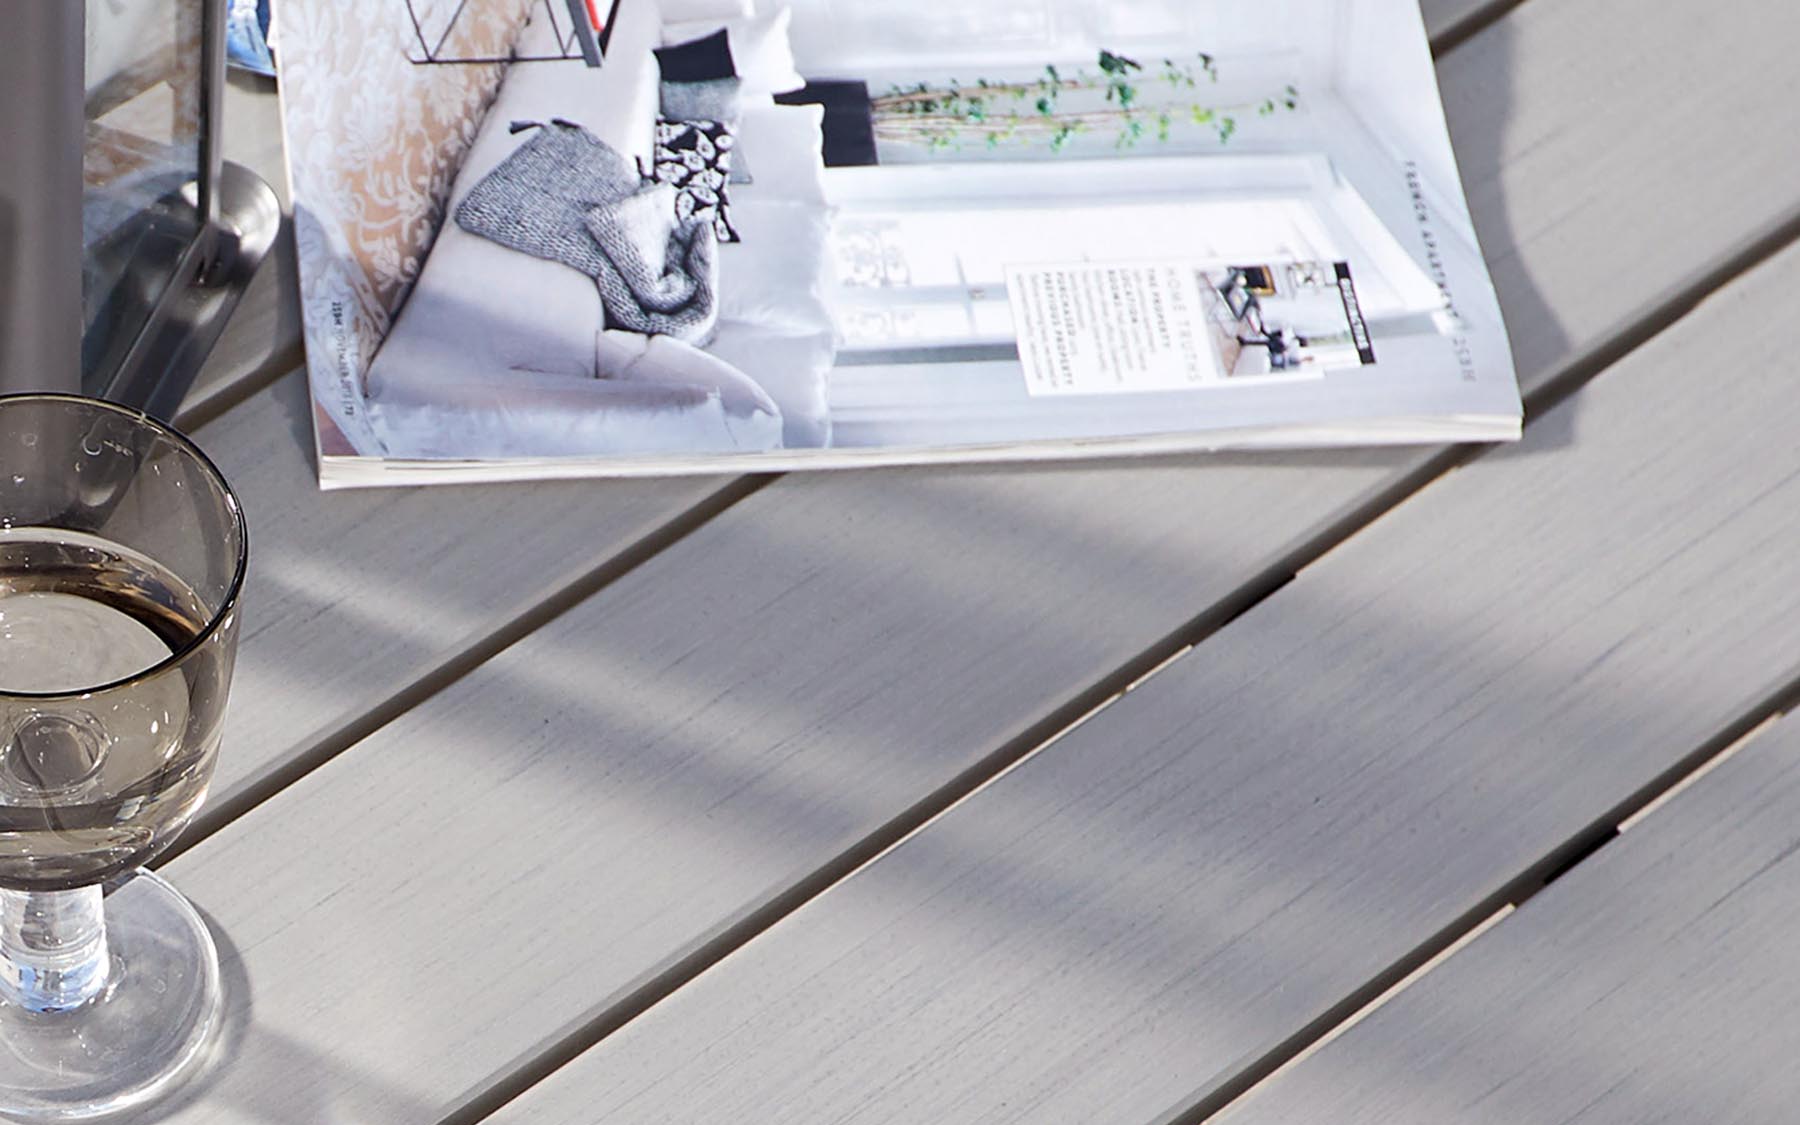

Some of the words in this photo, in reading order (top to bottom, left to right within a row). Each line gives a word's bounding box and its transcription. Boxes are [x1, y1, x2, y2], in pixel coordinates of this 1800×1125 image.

[1405, 160, 1428, 223] FRENCH
[1056, 271, 1075, 336] PURCHASED
[1120, 268, 1139, 323] LOCATION
[1148, 268, 1159, 288] THE
[1043, 272, 1061, 325] PREVIOUS
[1054, 330, 1073, 385] PROPERTY
[1152, 291, 1171, 348] PROPERTY
[1168, 268, 1186, 311] HOME
[1179, 320, 1202, 382] TRUTHS
